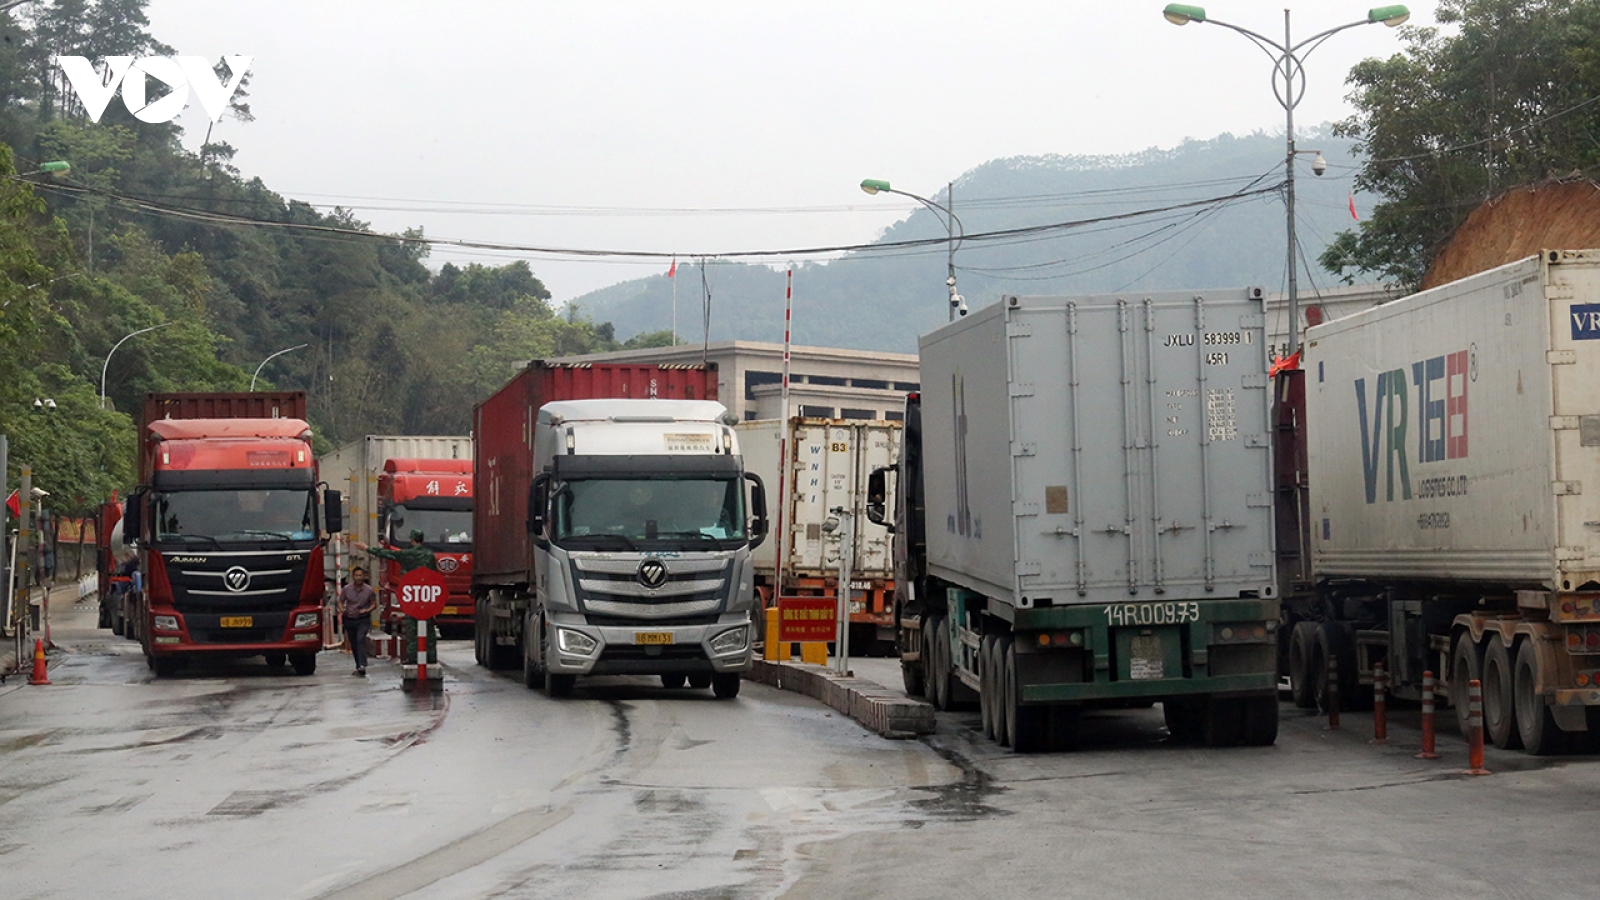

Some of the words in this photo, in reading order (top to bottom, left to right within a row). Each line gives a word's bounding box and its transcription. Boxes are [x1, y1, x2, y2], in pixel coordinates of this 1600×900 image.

[1164, 334, 1195, 346] JXLU
[1204, 332, 1241, 345] 583999
[1246, 331, 1252, 344] 1
[1206, 353, 1229, 365] 45R1
[831, 443, 847, 452] B3
[402, 585, 442, 602] STOP
[1104, 602, 1200, 626] 14R.009.73
